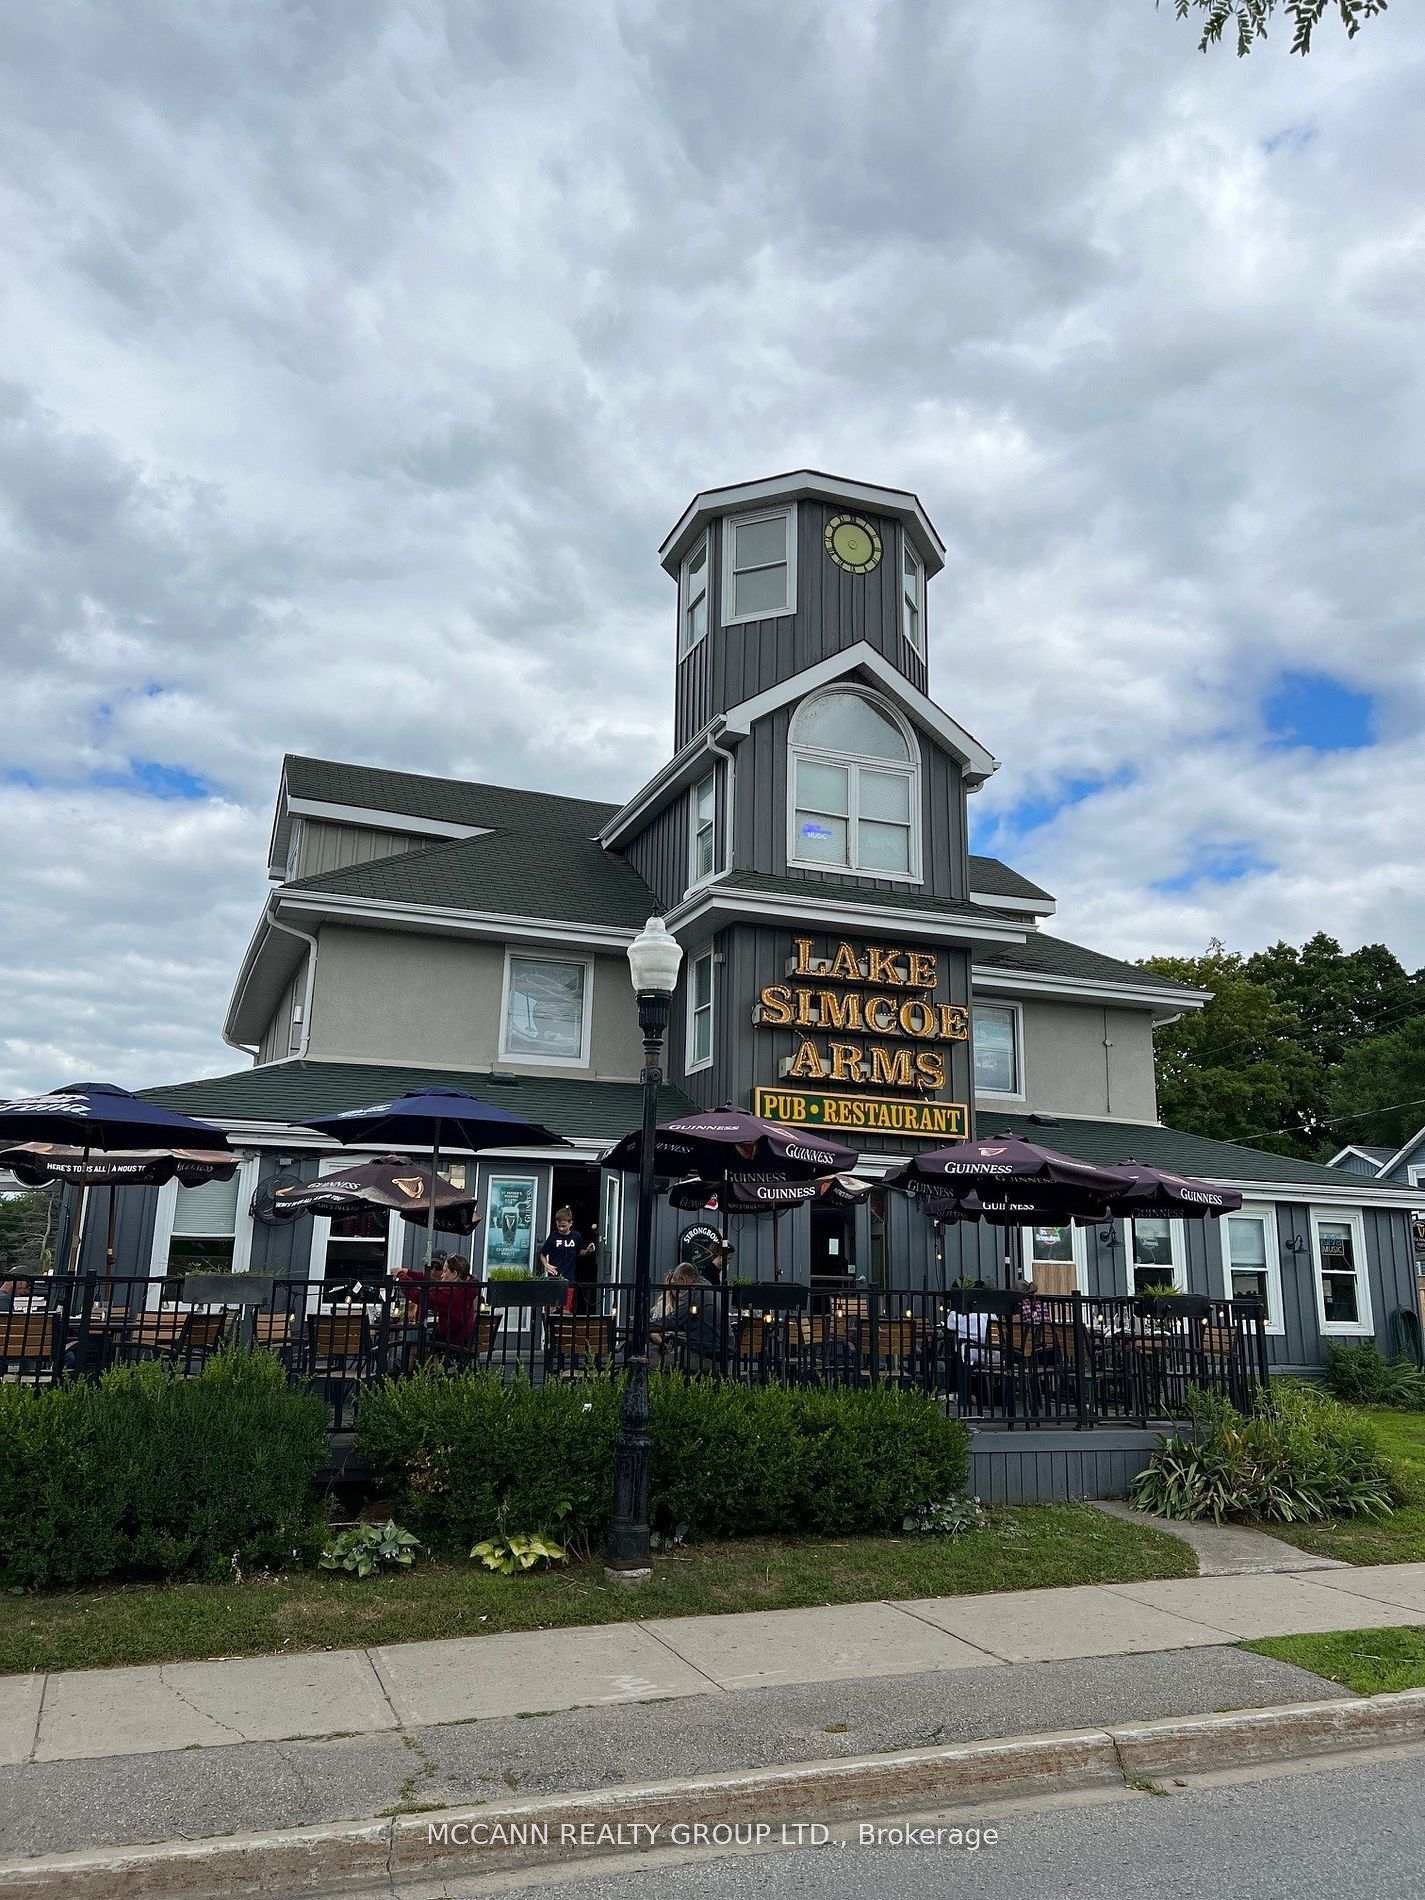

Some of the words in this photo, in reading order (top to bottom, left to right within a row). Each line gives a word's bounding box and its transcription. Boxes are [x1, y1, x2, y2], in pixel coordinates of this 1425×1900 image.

[793, 938, 938, 989] LAKE
[760, 984, 969, 1041] SIMCOE
[788, 1040, 944, 1089] ARMS
[764, 1094, 807, 1121] PUB
[823, 1099, 960, 1133] RESTAURANT
[785, 1143, 836, 1165] GUINNESS
[46, 1162, 72, 1172] HERE'S
[94, 1165, 107, 1173] ALL
[944, 1161, 1013, 1174] GUINNESS
[757, 1186, 816, 1200] GUINNESS
[907, 1178, 955, 1198] GUINNESS
[1180, 1187, 1224, 1206] GUINNESS
[982, 1201, 1035, 1211] GUINESS
[555, 1239, 576, 1248] FLA
